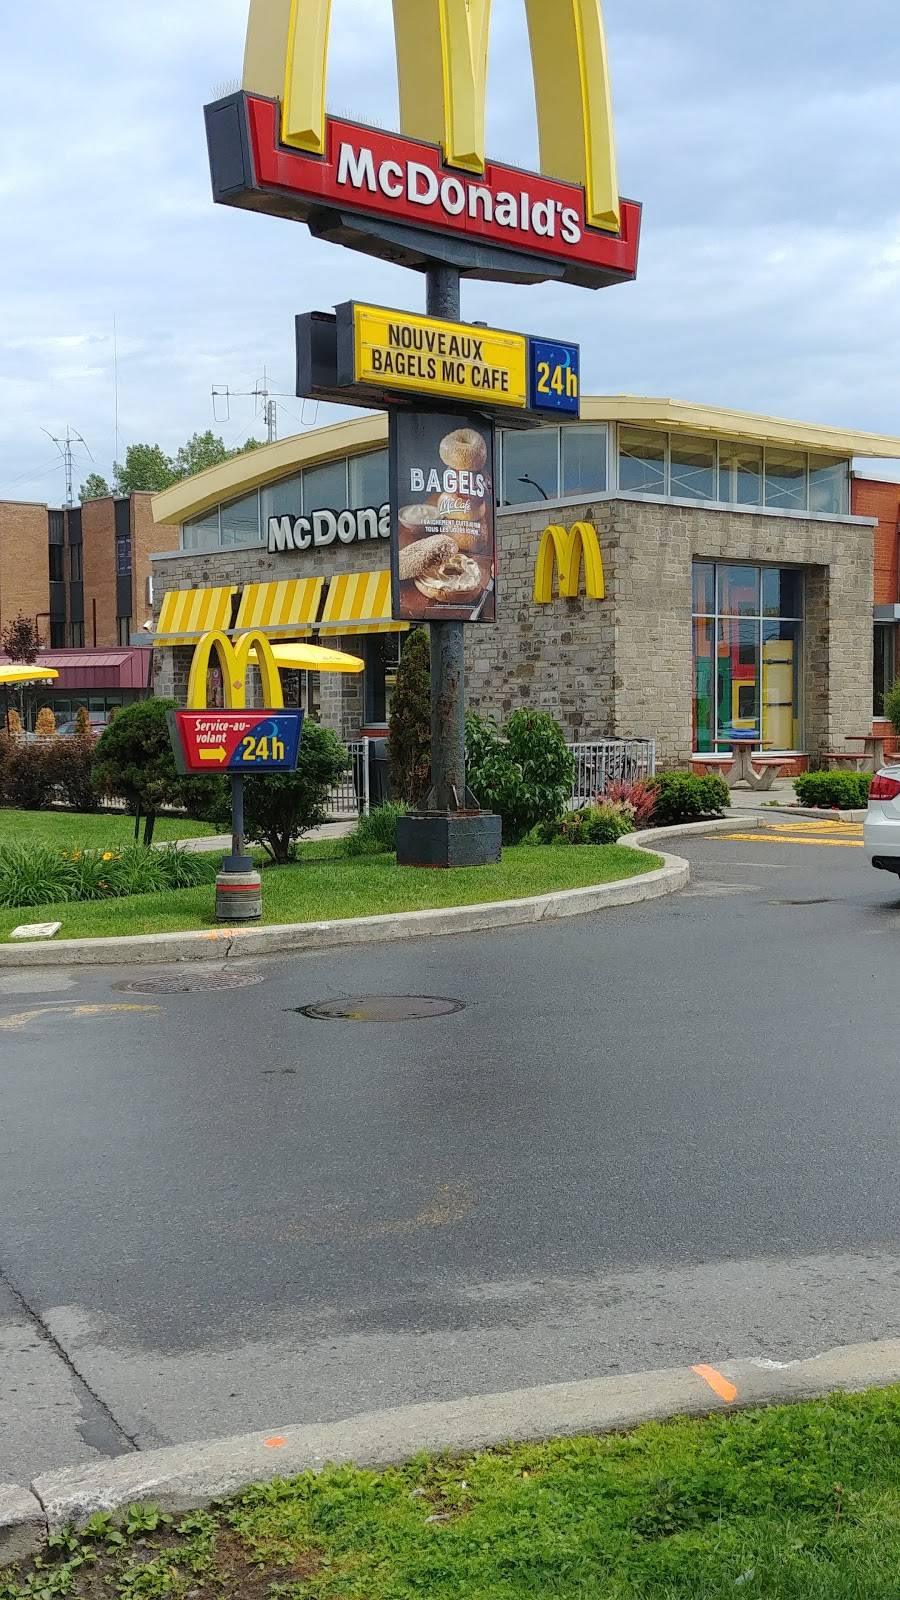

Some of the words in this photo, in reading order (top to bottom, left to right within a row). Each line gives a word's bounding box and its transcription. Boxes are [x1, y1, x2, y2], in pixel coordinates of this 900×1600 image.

[337, 142, 583, 245] McDonald's
[388, 323, 483, 362] NOUVEAUX
[371, 348, 437, 380] BAGELS
[442, 360, 465, 385] MC
[471, 365, 509, 392] CAFE
[536, 362, 579, 398] 24h
[410, 467, 485, 498] BAGELS
[194, 719, 251, 732] Service-au-
[195, 731, 227, 744] volant
[242, 736, 285, 762] 24h
